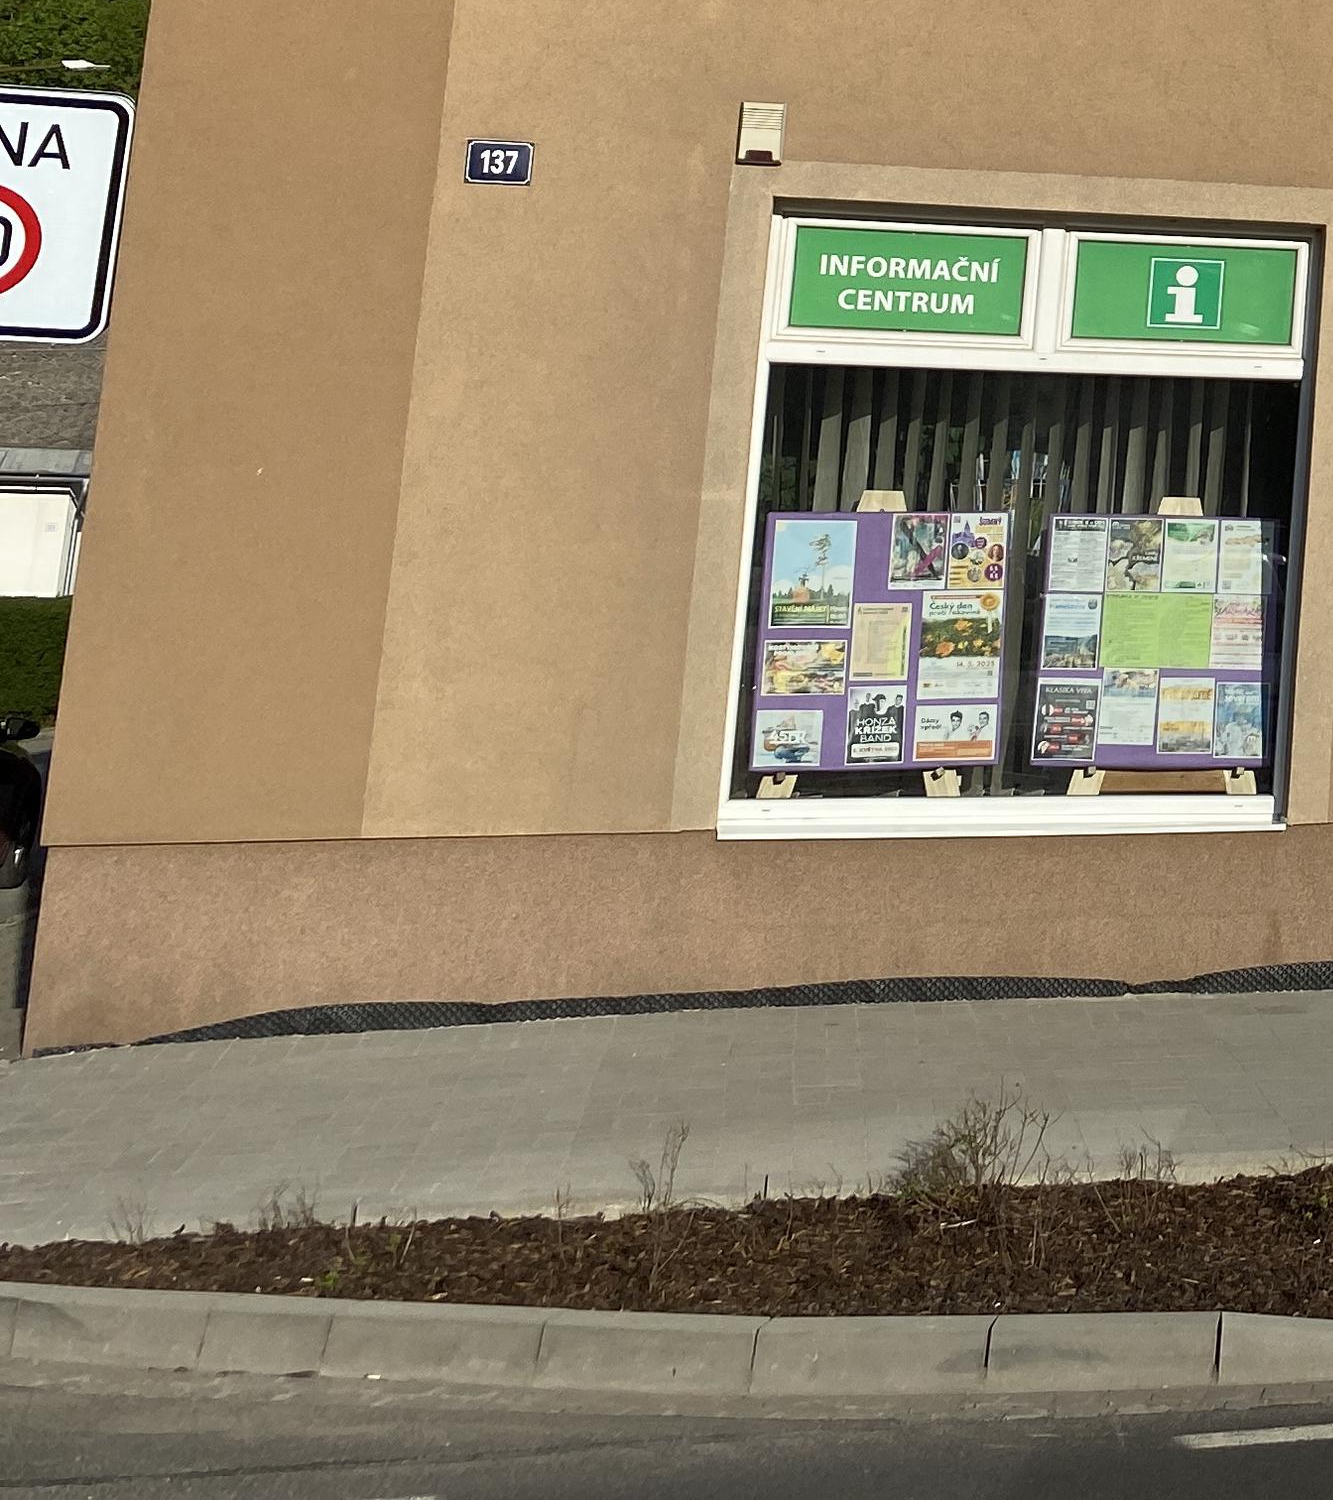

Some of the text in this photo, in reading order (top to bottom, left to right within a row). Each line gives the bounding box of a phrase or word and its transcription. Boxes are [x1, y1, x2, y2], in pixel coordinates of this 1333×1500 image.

[0, 121, 71, 170] NA
[480, 149, 519, 174] 137
[819, 253, 1002, 283] INFORMAČNÍ
[837, 288, 975, 315] CENTRUM
[856, 717, 896, 726] HONZA
[860, 734, 892, 743] BAND
